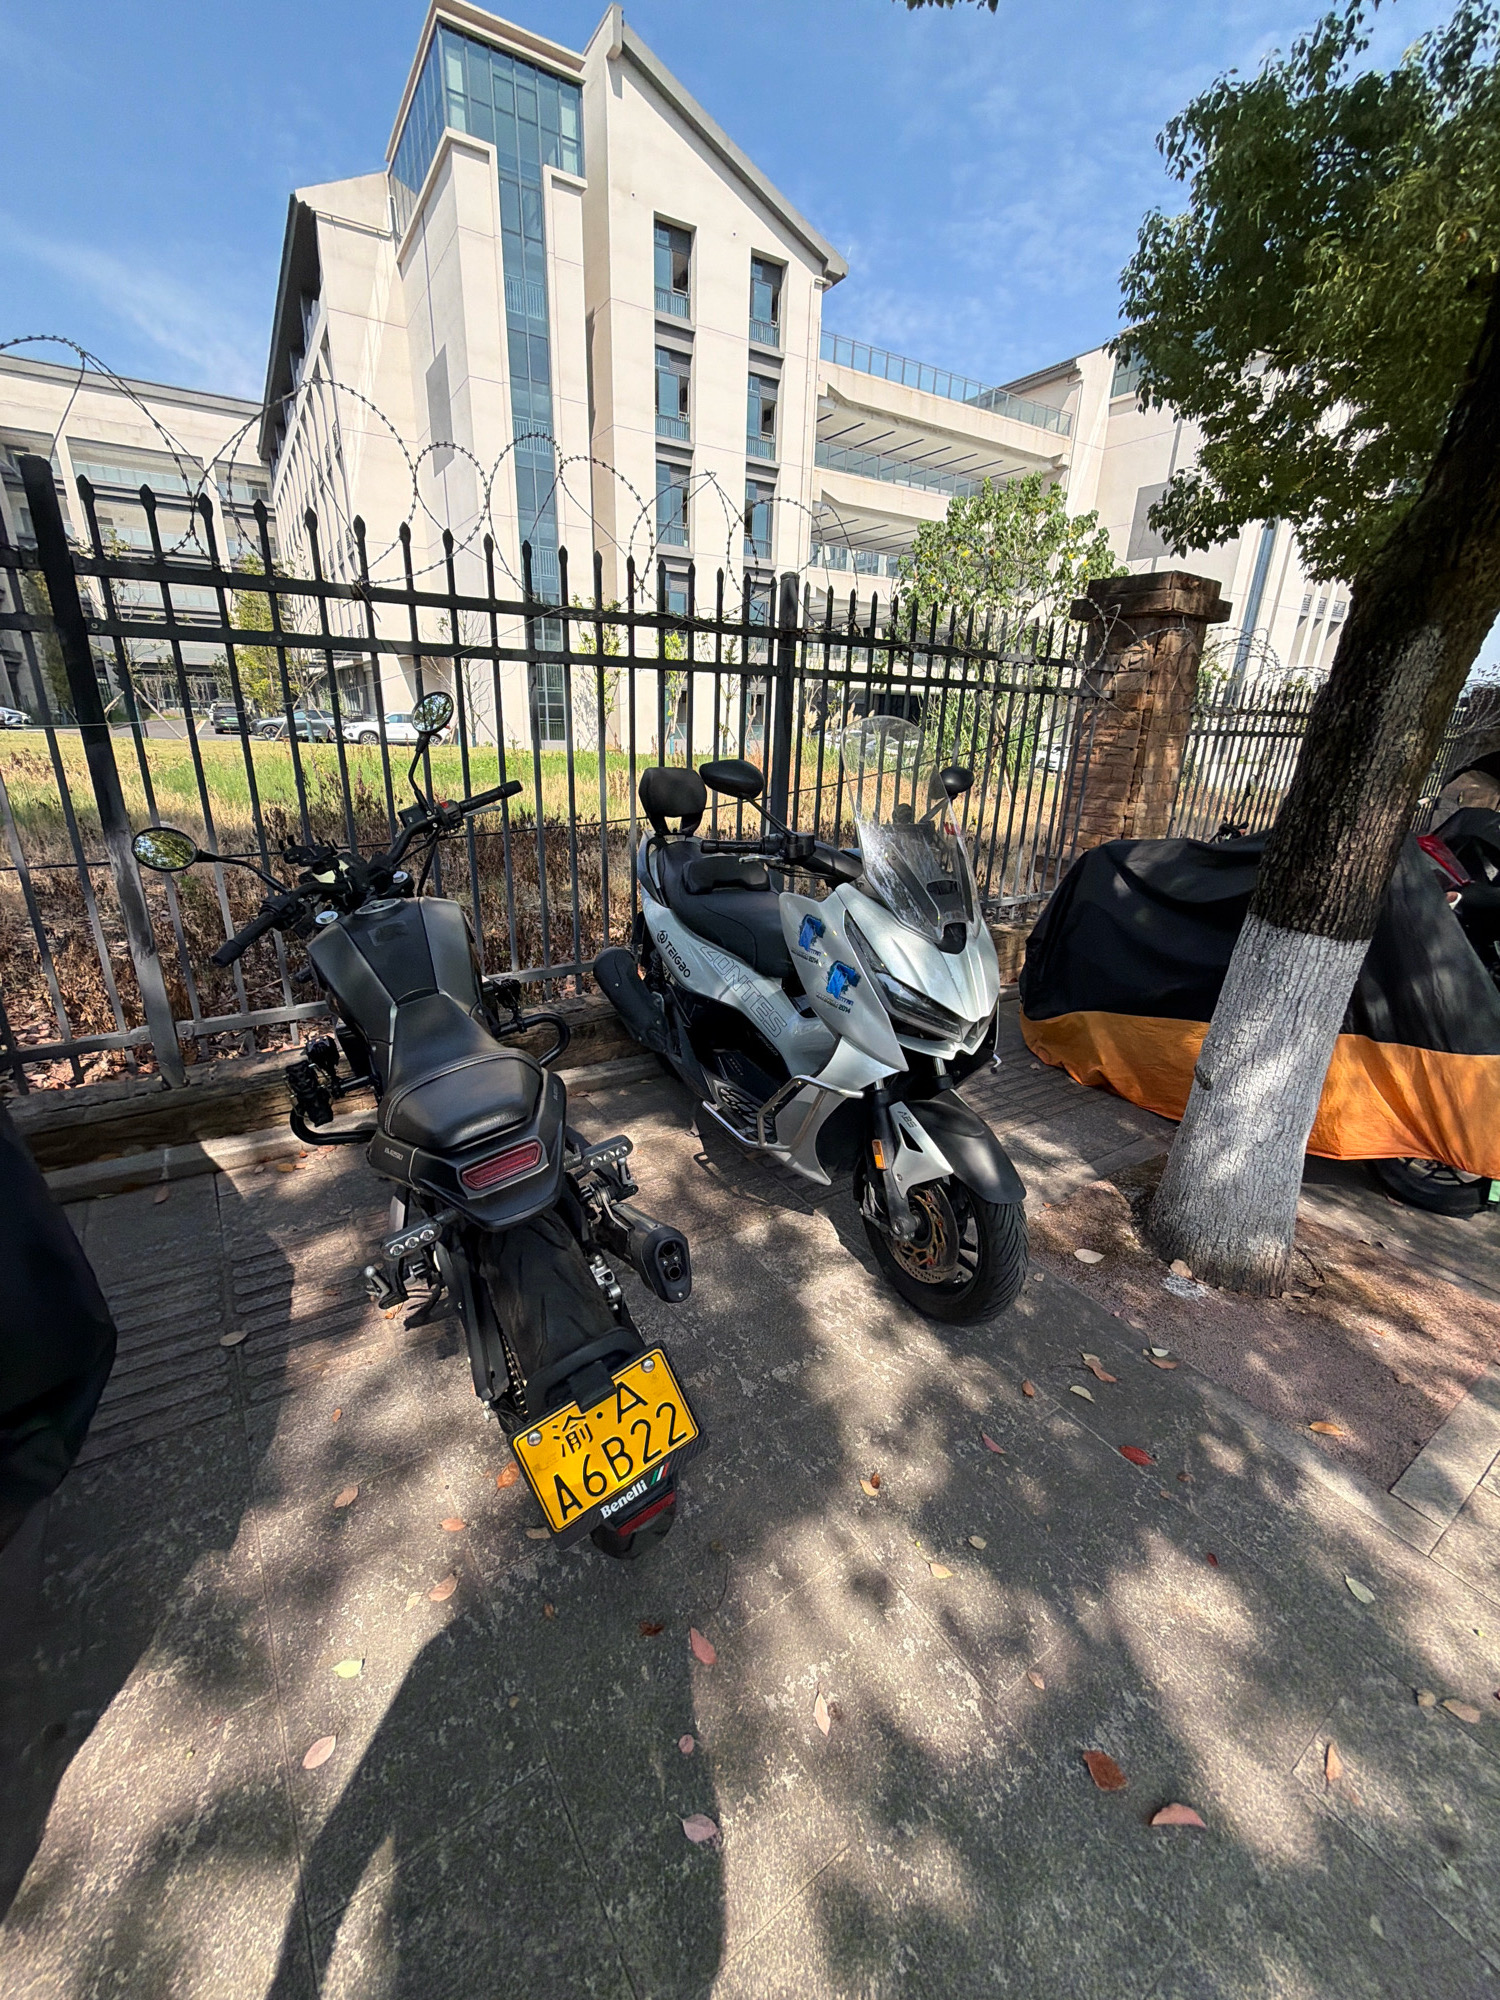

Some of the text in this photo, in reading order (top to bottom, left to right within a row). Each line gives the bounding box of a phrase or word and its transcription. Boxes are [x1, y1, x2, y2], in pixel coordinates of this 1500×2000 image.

[666, 941, 691, 978] TEIGBO
[700, 946, 788, 1038] ZONTES
[897, 1111, 917, 1128] ABS
[553, 1402, 687, 1521] A6B22
[600, 1480, 648, 1519] Benelli
